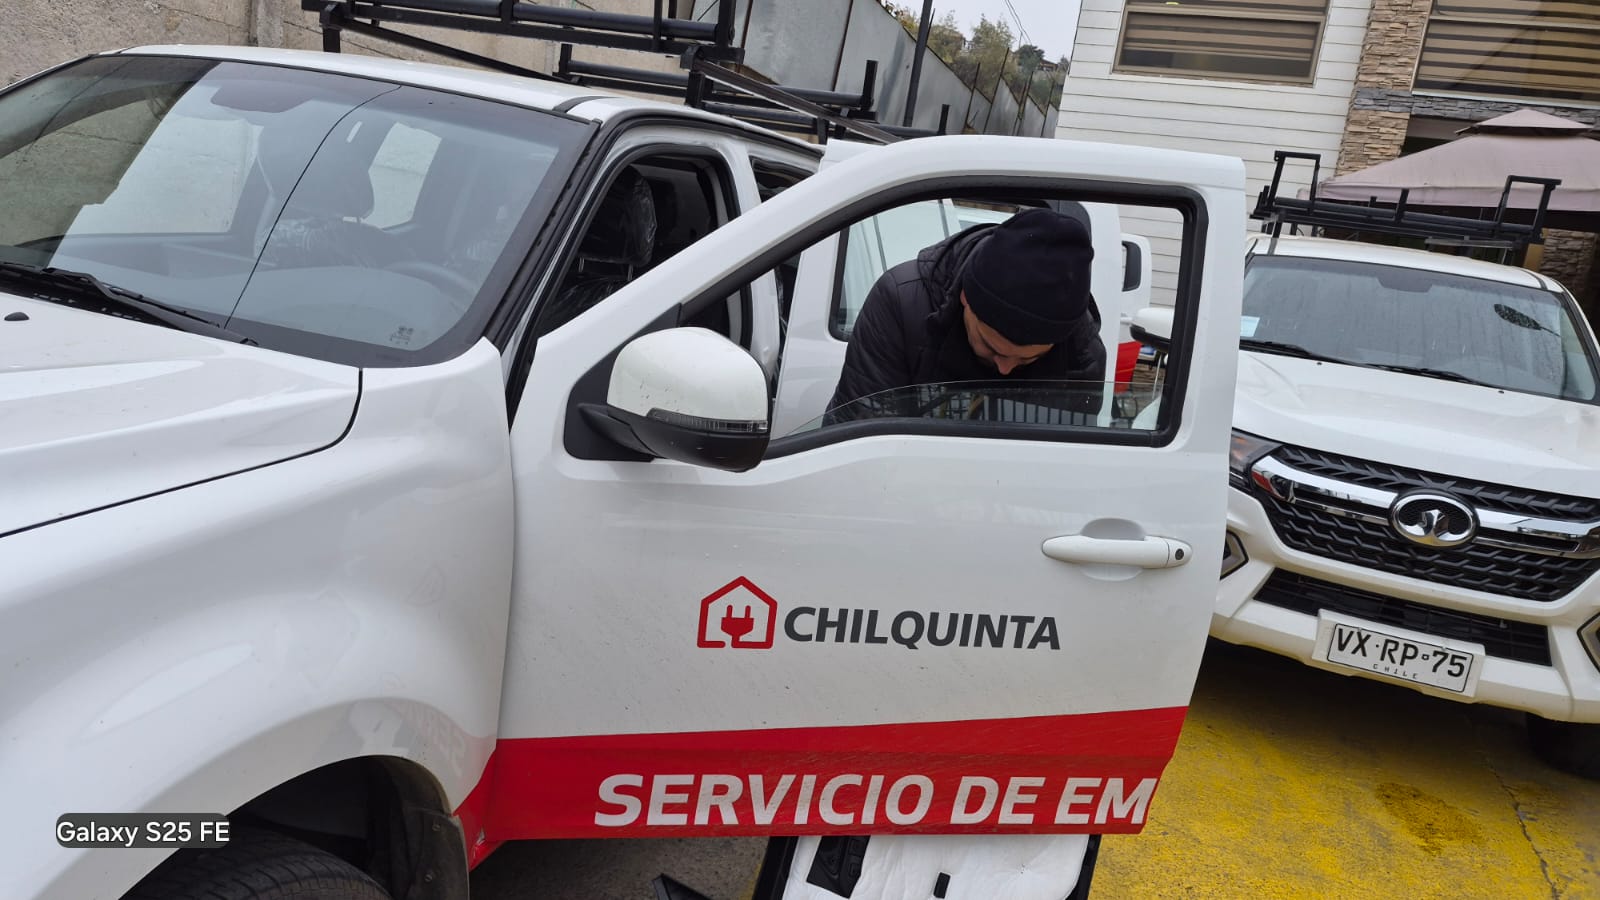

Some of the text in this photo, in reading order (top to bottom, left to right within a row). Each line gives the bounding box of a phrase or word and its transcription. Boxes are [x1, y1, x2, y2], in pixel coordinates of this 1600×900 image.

[784, 606, 1061, 650] CHILQUINTA
[1373, 663, 1418, 680] CHILE
[594, 774, 1157, 826] SERVICIO DE EM
